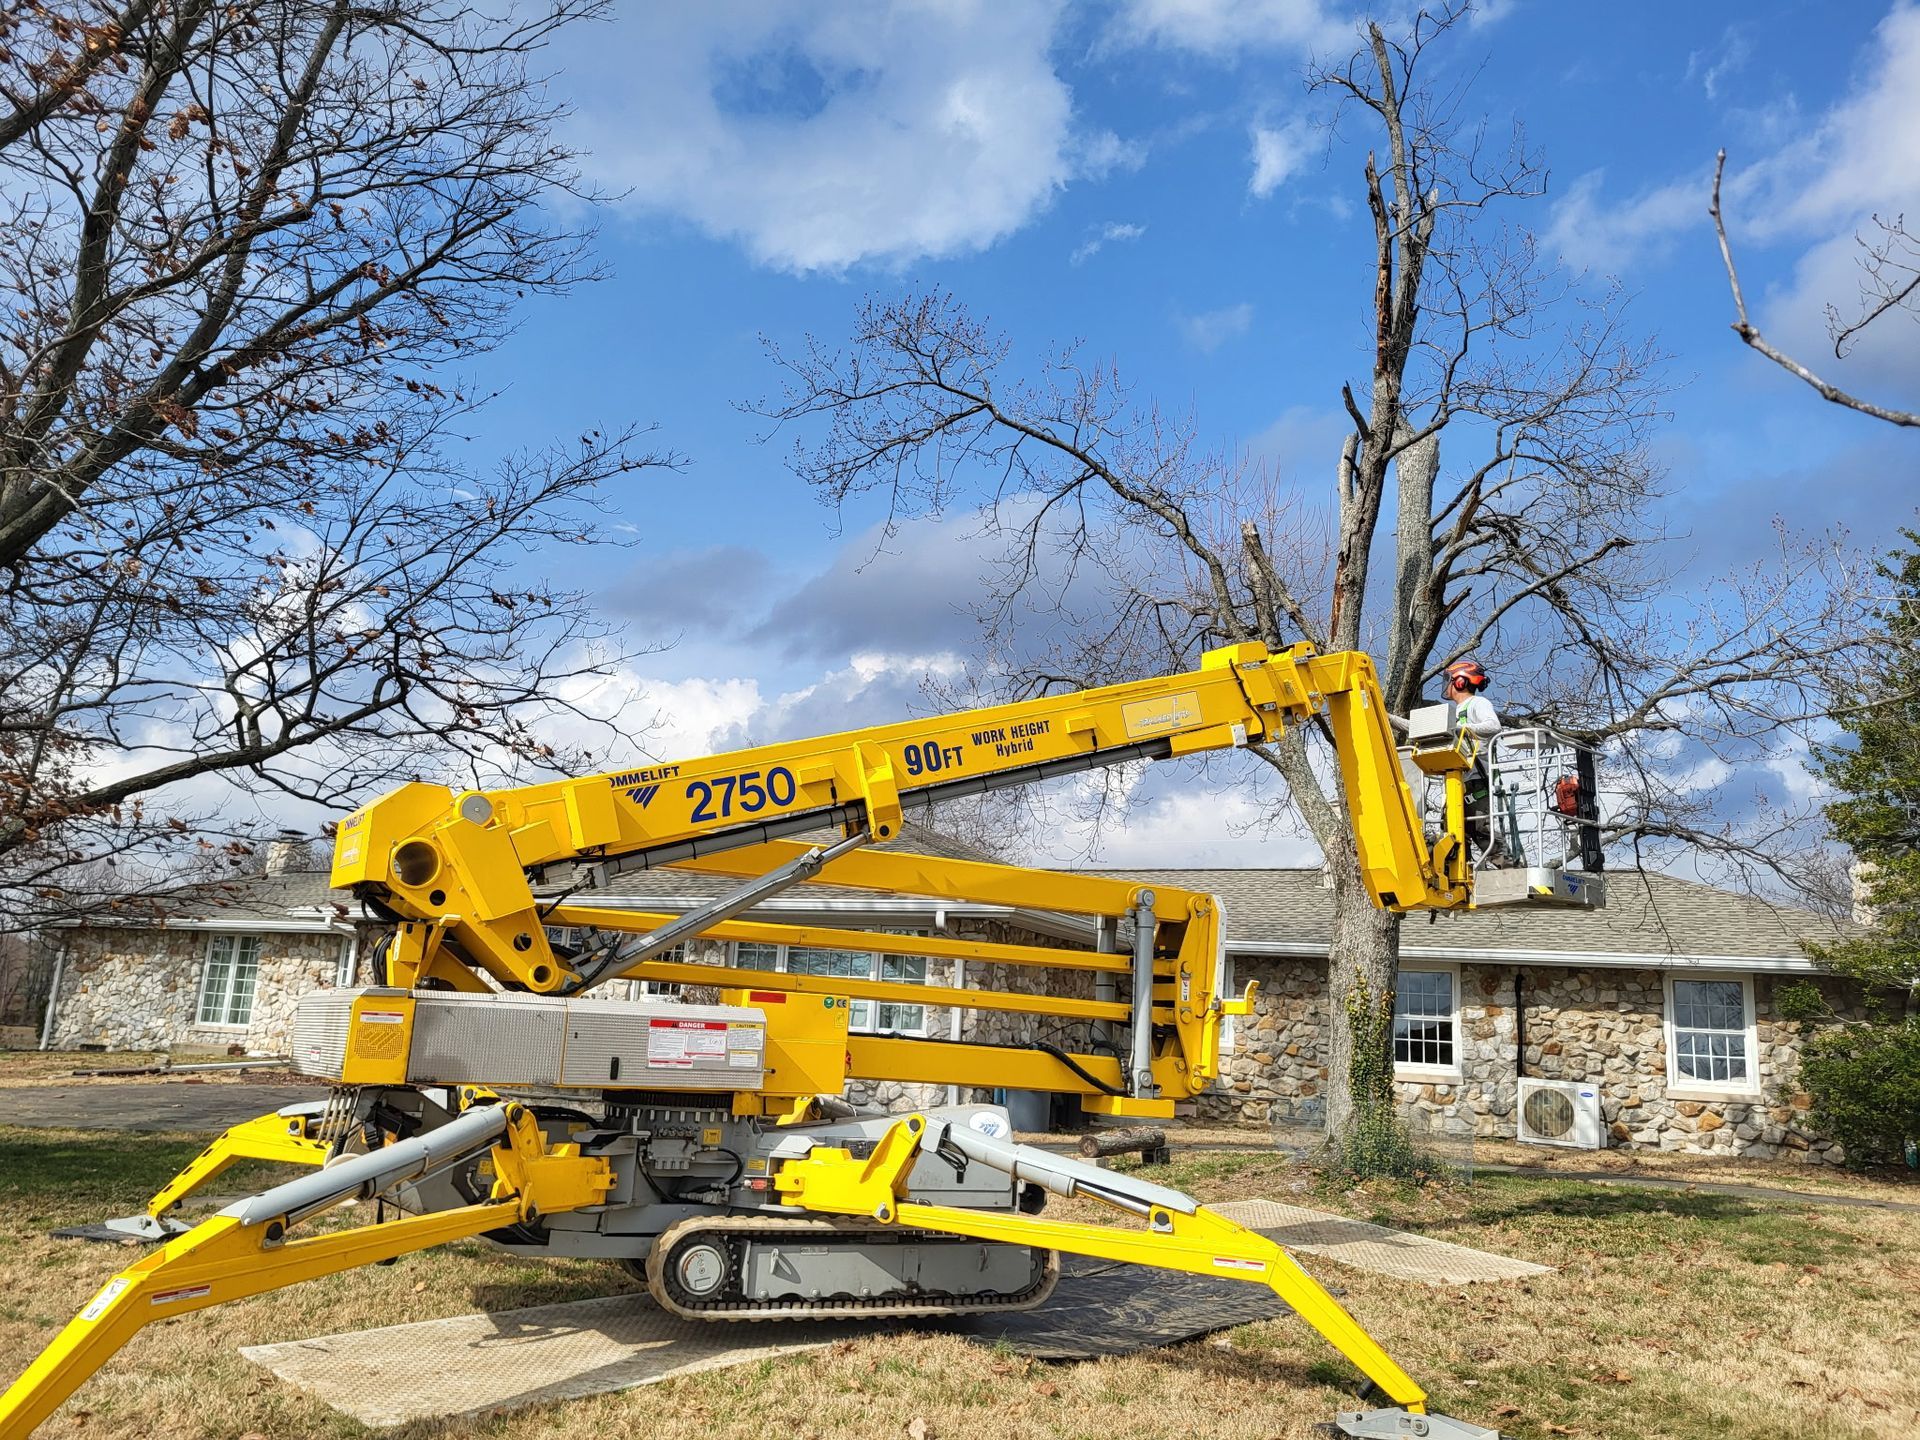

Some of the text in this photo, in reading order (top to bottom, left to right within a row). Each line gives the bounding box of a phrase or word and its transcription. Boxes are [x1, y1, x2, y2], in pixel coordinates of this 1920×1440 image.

[971, 720, 1050, 746] WORK HEIGHT
[996, 738, 1034, 757] Hybrid
[904, 741, 963, 776] 90FT
[685, 766, 796, 824] 2750
